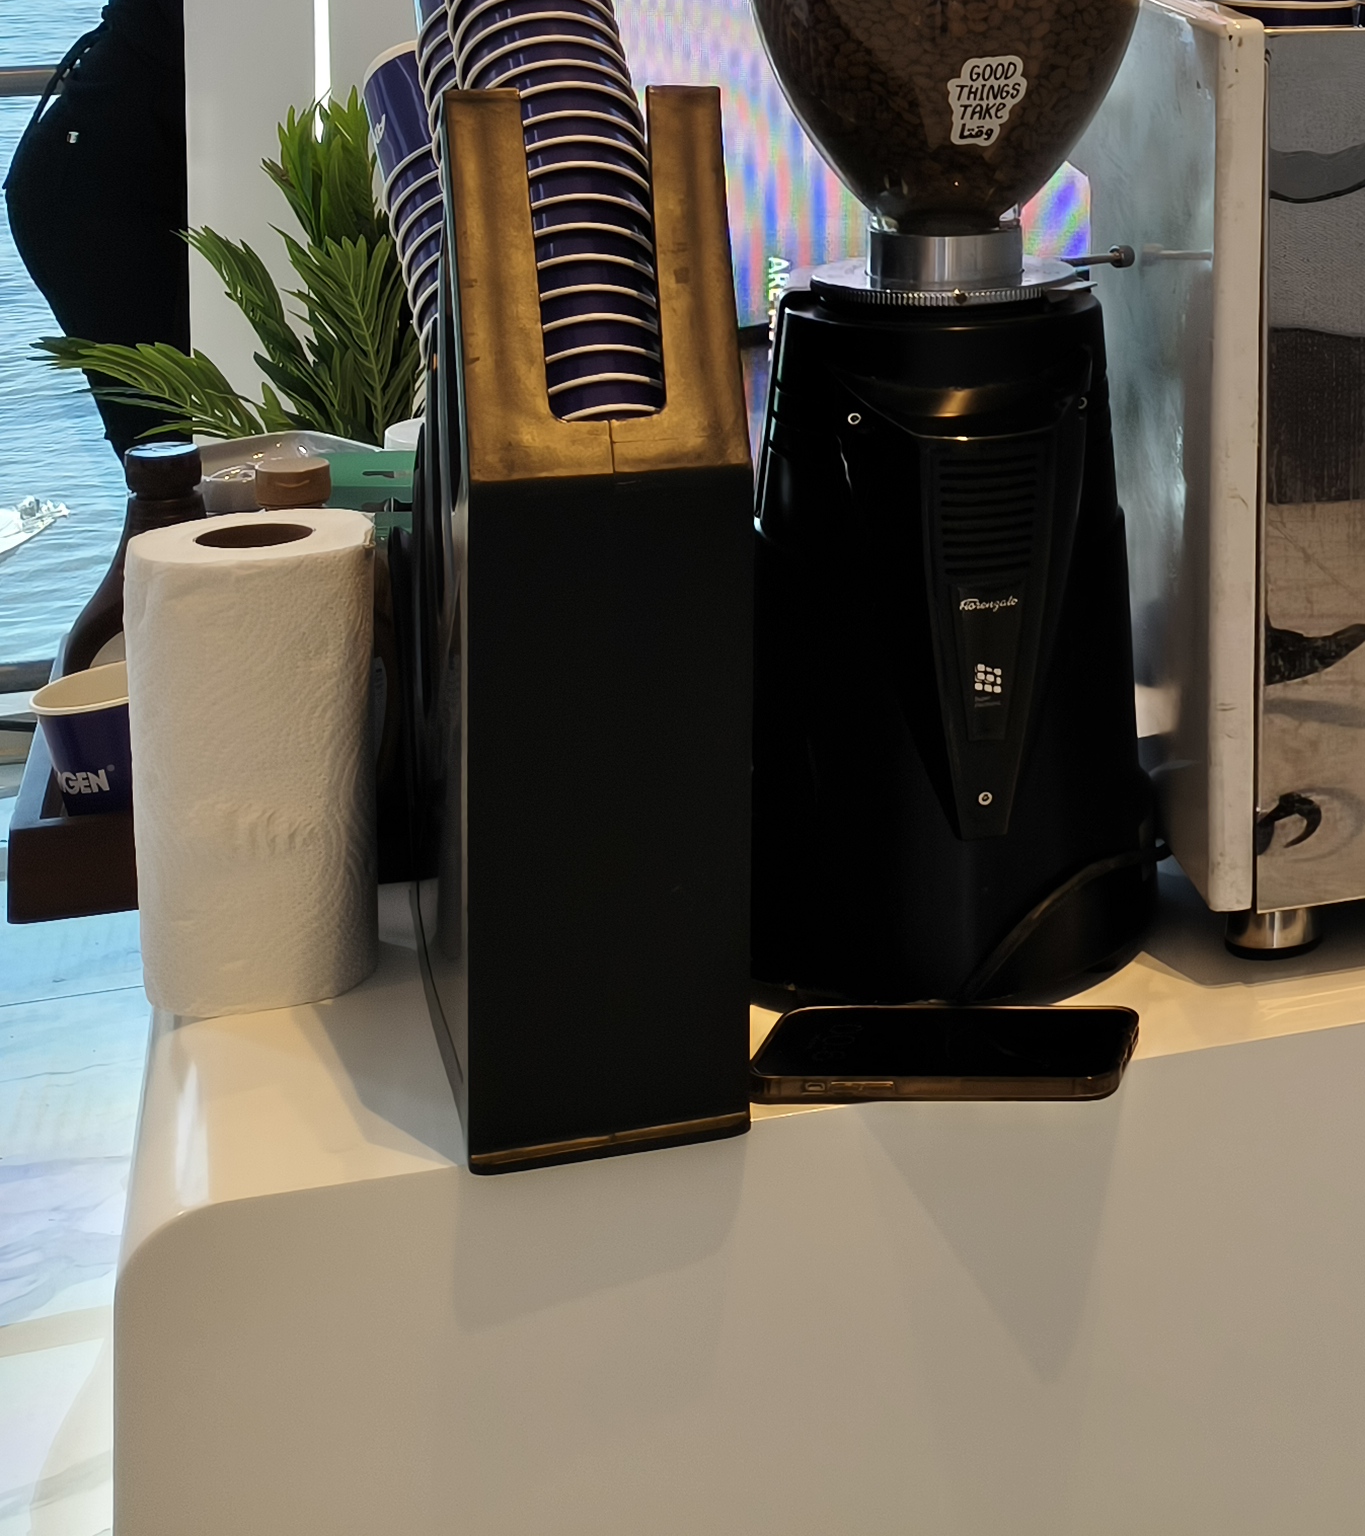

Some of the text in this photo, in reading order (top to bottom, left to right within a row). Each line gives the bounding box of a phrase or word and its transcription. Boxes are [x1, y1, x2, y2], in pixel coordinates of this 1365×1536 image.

[969, 62, 1017, 82] GOOD
[955, 82, 1021, 102] THINGS
[57, 768, 110, 795] GEN
